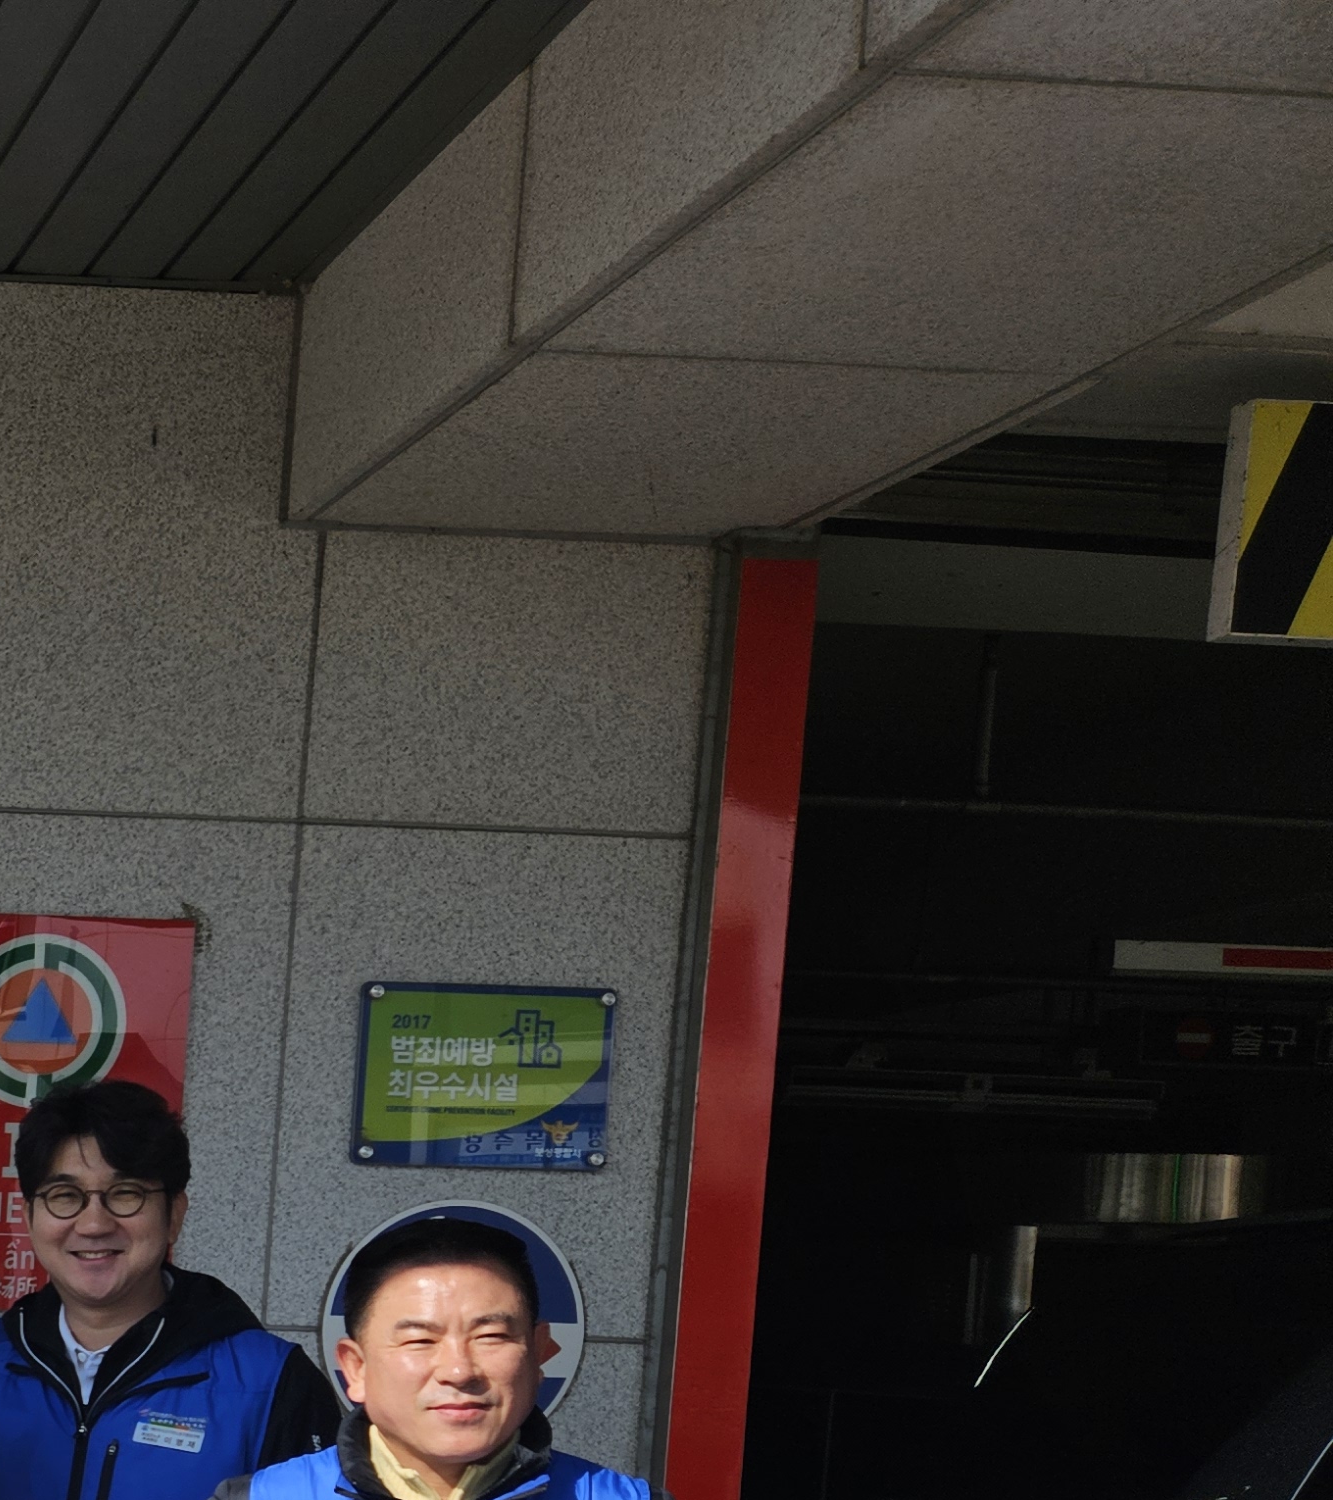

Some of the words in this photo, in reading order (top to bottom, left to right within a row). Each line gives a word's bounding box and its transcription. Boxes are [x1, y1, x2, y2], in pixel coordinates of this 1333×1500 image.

[391, 1014, 431, 1030] 2017
[390, 1035, 496, 1067] 범죄예방
[387, 1069, 519, 1103] 최우수시설
